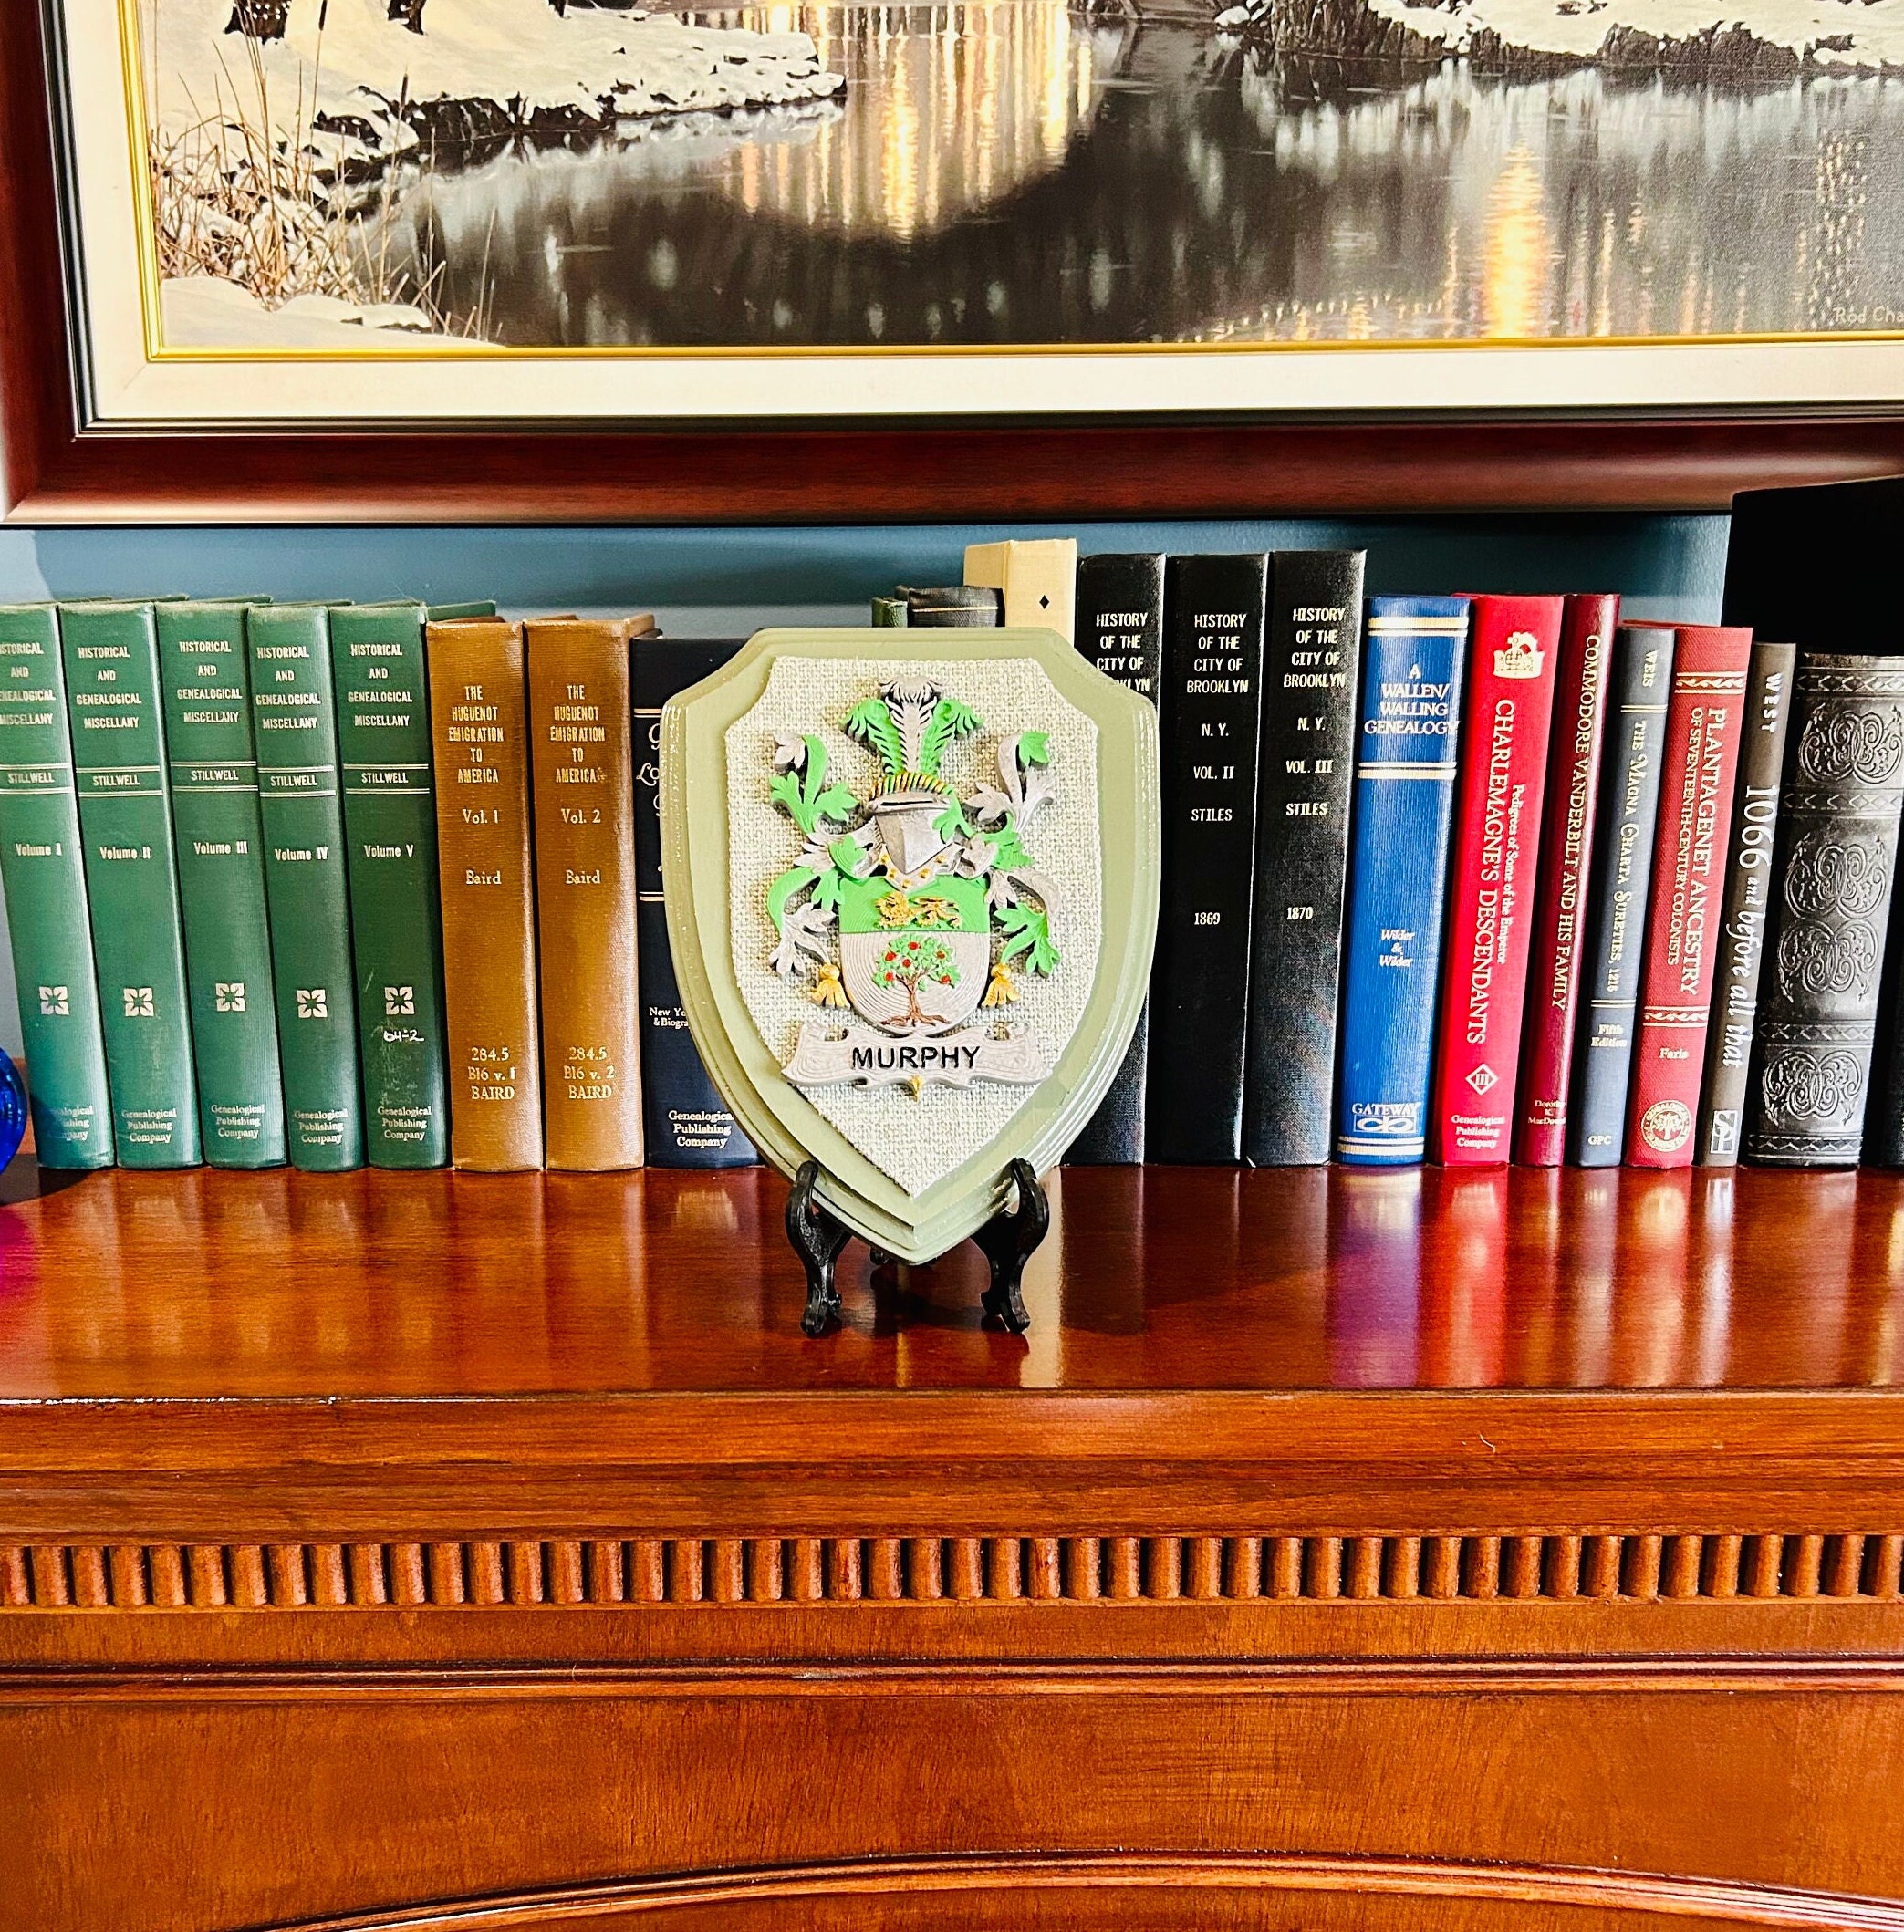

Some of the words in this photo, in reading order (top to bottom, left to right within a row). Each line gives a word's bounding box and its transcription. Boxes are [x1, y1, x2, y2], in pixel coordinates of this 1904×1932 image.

[1833, 306, 1867, 324] Rod
[1873, 305, 1904, 323] Cha
[1096, 612, 1148, 628] HISTORY
[1194, 614, 1247, 628] HISTORY
[1293, 608, 1346, 622] HISTORY
[1100, 635, 1116, 649] OF
[1120, 635, 1141, 649] THE
[1198, 637, 1213, 649] OF
[1219, 636, 1240, 649] THE
[1296, 630, 1312, 643] OF
[1316, 629, 1338, 644] THE
[78, 647, 130, 659] HISTORICAL
[179, 641, 232, 653] HISTORICAL
[256, 646, 309, 658] HISTORICAL
[350, 644, 403, 656] HISTORICAL
[1096, 657, 1126, 671] CITY
[1129, 657, 1144, 670] OF
[1194, 659, 1222, 671] CITY
[1227, 658, 1243, 670] OF
[1291, 652, 1320, 666] CITY
[1325, 652, 1340, 665] OF
[11, 667, 28, 678] AND
[97, 670, 116, 681] AND
[197, 665, 217, 676] AND
[276, 670, 295, 681] AND
[369, 668, 388, 679] AND
[1408, 664, 1421, 679] A
[1642, 650, 1657, 688] WEIS
[1187, 680, 1249, 693] BROOKLYN
[1284, 673, 1345, 688] BROOKLYN
[76, 693, 141, 705] GENEALOGICAL
[177, 689, 242, 700] GENEALOGICAL
[255, 693, 321, 705] GENEALOGICAL
[348, 691, 412, 702] GENEALOGICAL
[464, 685, 484, 701] THE
[567, 684, 586, 701] THE
[1575, 634, 1601, 753] COMMODORE
[1379, 702, 1449, 716] WALLING
[1761, 672, 1783, 733] WEST
[183, 712, 239, 723] MISCELLANY
[354, 715, 410, 726] MISCELLANY
[452, 706, 498, 722] HUGUENOT
[554, 706, 599, 722] HUGUENOT
[1691, 707, 1704, 727] OF
[84, 717, 139, 729] MISCELLANY
[262, 717, 317, 729] MISCELLANY
[1364, 721, 1460, 734] GENEALOGY
[448, 726, 504, 743] EMIGRATION
[549, 726, 606, 742] EMIGRATION
[1631, 721, 1645, 751] THE
[470, 747, 483, 763] TO
[571, 747, 584, 763] TO
[1193, 767, 1217, 779] VOL.
[1223, 766, 1234, 779] II
[1285, 760, 1310, 774] VOL.
[1315, 760, 1333, 773] III
[7, 772, 55, 784] STILLWELL
[93, 774, 140, 786] STILLWELL
[192, 769, 239, 781] STILLWELL
[270, 774, 317, 786] STILLWELL
[361, 772, 409, 784] STILLWELL
[457, 768, 499, 784] AMERICA
[556, 768, 597, 784] AMERICA
[1481, 699, 1515, 882] CHARLEMAGNE'S
[1693, 707, 1728, 877] PLANTAGENET
[463, 808, 488, 824] Vol.
[561, 808, 587, 824] Vol.
[592, 809, 601, 823] 2
[1191, 808, 1233, 822] STILES
[1285, 803, 1327, 816] STILES
[1508, 784, 1525, 835] Pedigrees
[1564, 758, 1589, 868] VANDERBILT
[1739, 784, 1777, 868] 1066
[193, 842, 231, 855] Volume
[236, 841, 248, 854] III
[1507, 837, 1520, 850] of
[16, 844, 51, 857] Volume
[56, 844, 62, 856] I
[100, 847, 137, 859] Volume
[141, 847, 151, 858] II
[275, 848, 312, 860] Volume
[317, 847, 328, 859] IV
[364, 845, 401, 857] Volume
[406, 844, 414, 857] V
[1504, 850, 1518, 882] Some
[465, 869, 503, 885] Baird
[565, 869, 601, 885] Baird
[1503, 883, 1516, 898] of
[1560, 871, 1576, 910] AND
[1745, 877, 1763, 906] and
[1286, 907, 1313, 919] 1870
[1502, 898, 1514, 915] the
[1194, 912, 1221, 925] 1869
[1555, 915, 1573, 941] HIS
[1668, 891, 1685, 966] COLONISTS
[1380, 929, 1415, 941] Wilder
[1497, 917, 1514, 965] Emperor
[1680, 879, 1709, 995] ANCESTRY
[1726, 910, 1765, 978] before
[1379, 954, 1413, 967] Wilder
[1467, 888, 1498, 1044] DESCENDANTS
[1552, 947, 1570, 1011] FAMILY
[1607, 969, 1619, 992] 1215
[1728, 986, 1757, 1016] all
[650, 1007, 670, 1016] New
[1598, 1024, 1624, 1034] Fifth
[1591, 1037, 1627, 1047] Edition
[1722, 1024, 1753, 1067] that
[471, 1046, 510, 1062] 284.5
[568, 1046, 607, 1061] 284.5
[852, 1045, 980, 1069] MURPHY
[1659, 1048, 1689, 1059] Faris
[606, 1065, 616, 1079] 2
[471, 1085, 515, 1100] BAIRD
[567, 1085, 613, 1099] BAIRD
[121, 1107, 177, 1118] Genealogical
[211, 1104, 265, 1115] Genealogical
[294, 1108, 348, 1120] Genealogical
[377, 1106, 432, 1117] Genealogical
[1352, 1103, 1422, 1116] GATEWAY
[127, 1120, 172, 1131] Publishing
[215, 1117, 261, 1127] Publishing
[298, 1121, 344, 1132] Publishing
[381, 1117, 427, 1129] Publishing
[1451, 1115, 1505, 1126] Genealogical
[217, 1127, 259, 1139] Company
[384, 1129, 425, 1141] Company
[673, 1124, 732, 1136] Publishing
[1455, 1127, 1500, 1137] Publishing
[129, 1133, 172, 1144] Company
[301, 1132, 343, 1145] Company
[676, 1137, 728, 1148] Company
[1457, 1138, 1497, 1149] Company
[1588, 1136, 1612, 1146] GPC
